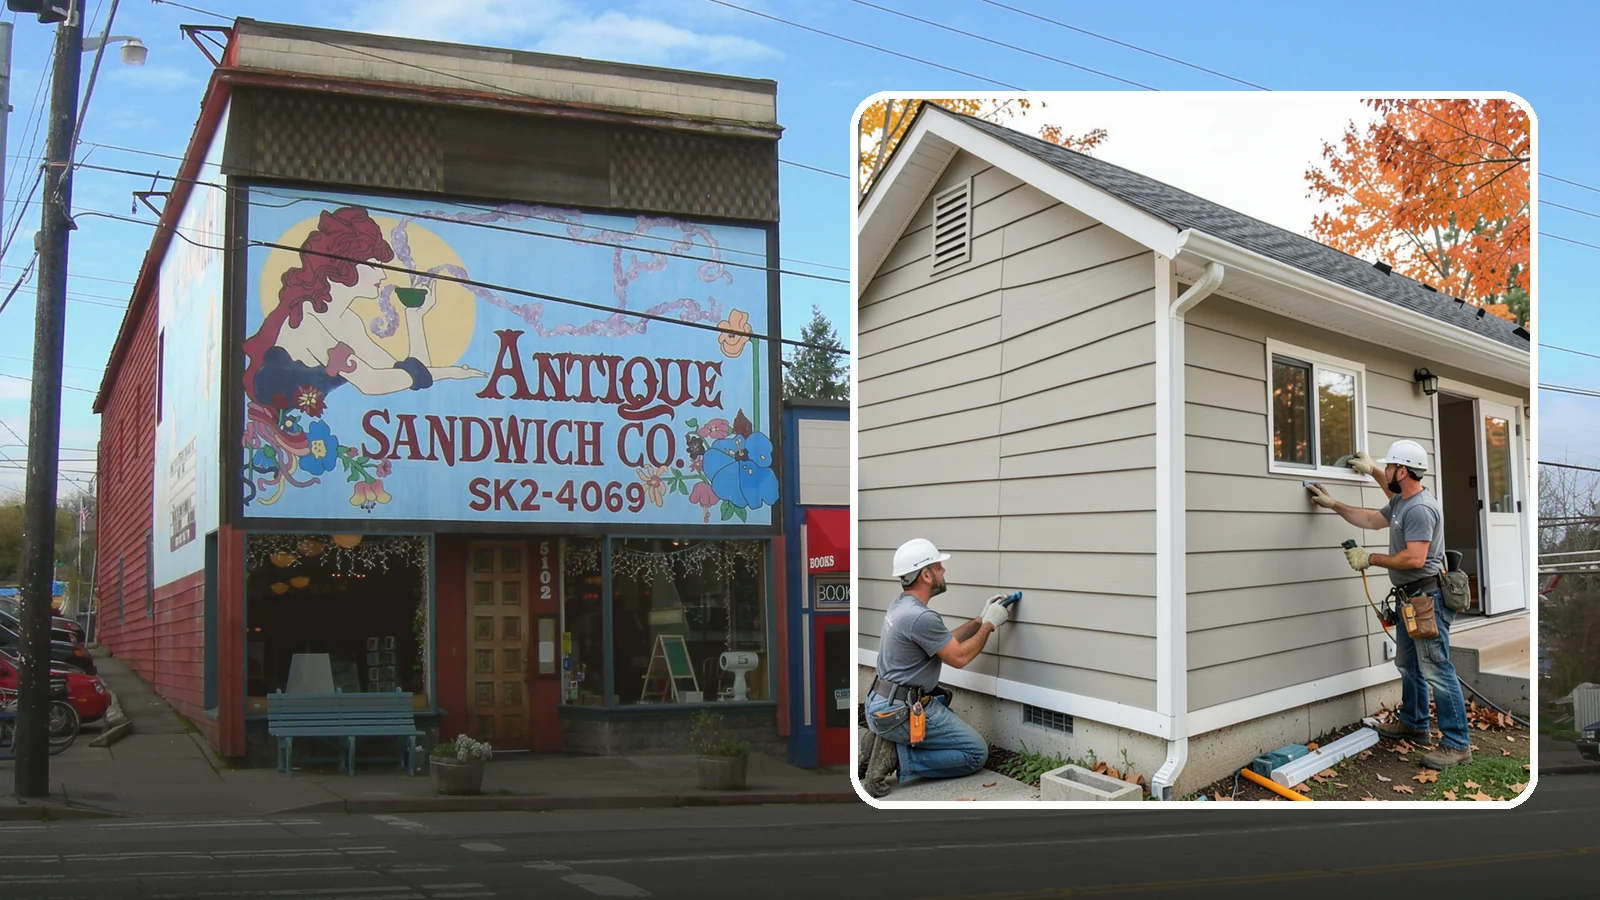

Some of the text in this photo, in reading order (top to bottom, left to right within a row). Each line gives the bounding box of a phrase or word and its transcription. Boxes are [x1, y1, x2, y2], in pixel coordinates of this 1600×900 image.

[477, 330, 723, 420] ANTIQUE
[361, 409, 685, 468] SANDWICH CO.
[469, 478, 645, 512] SK2-4069
[540, 541, 551, 600] 5102
[809, 555, 835, 569] BOOKS
